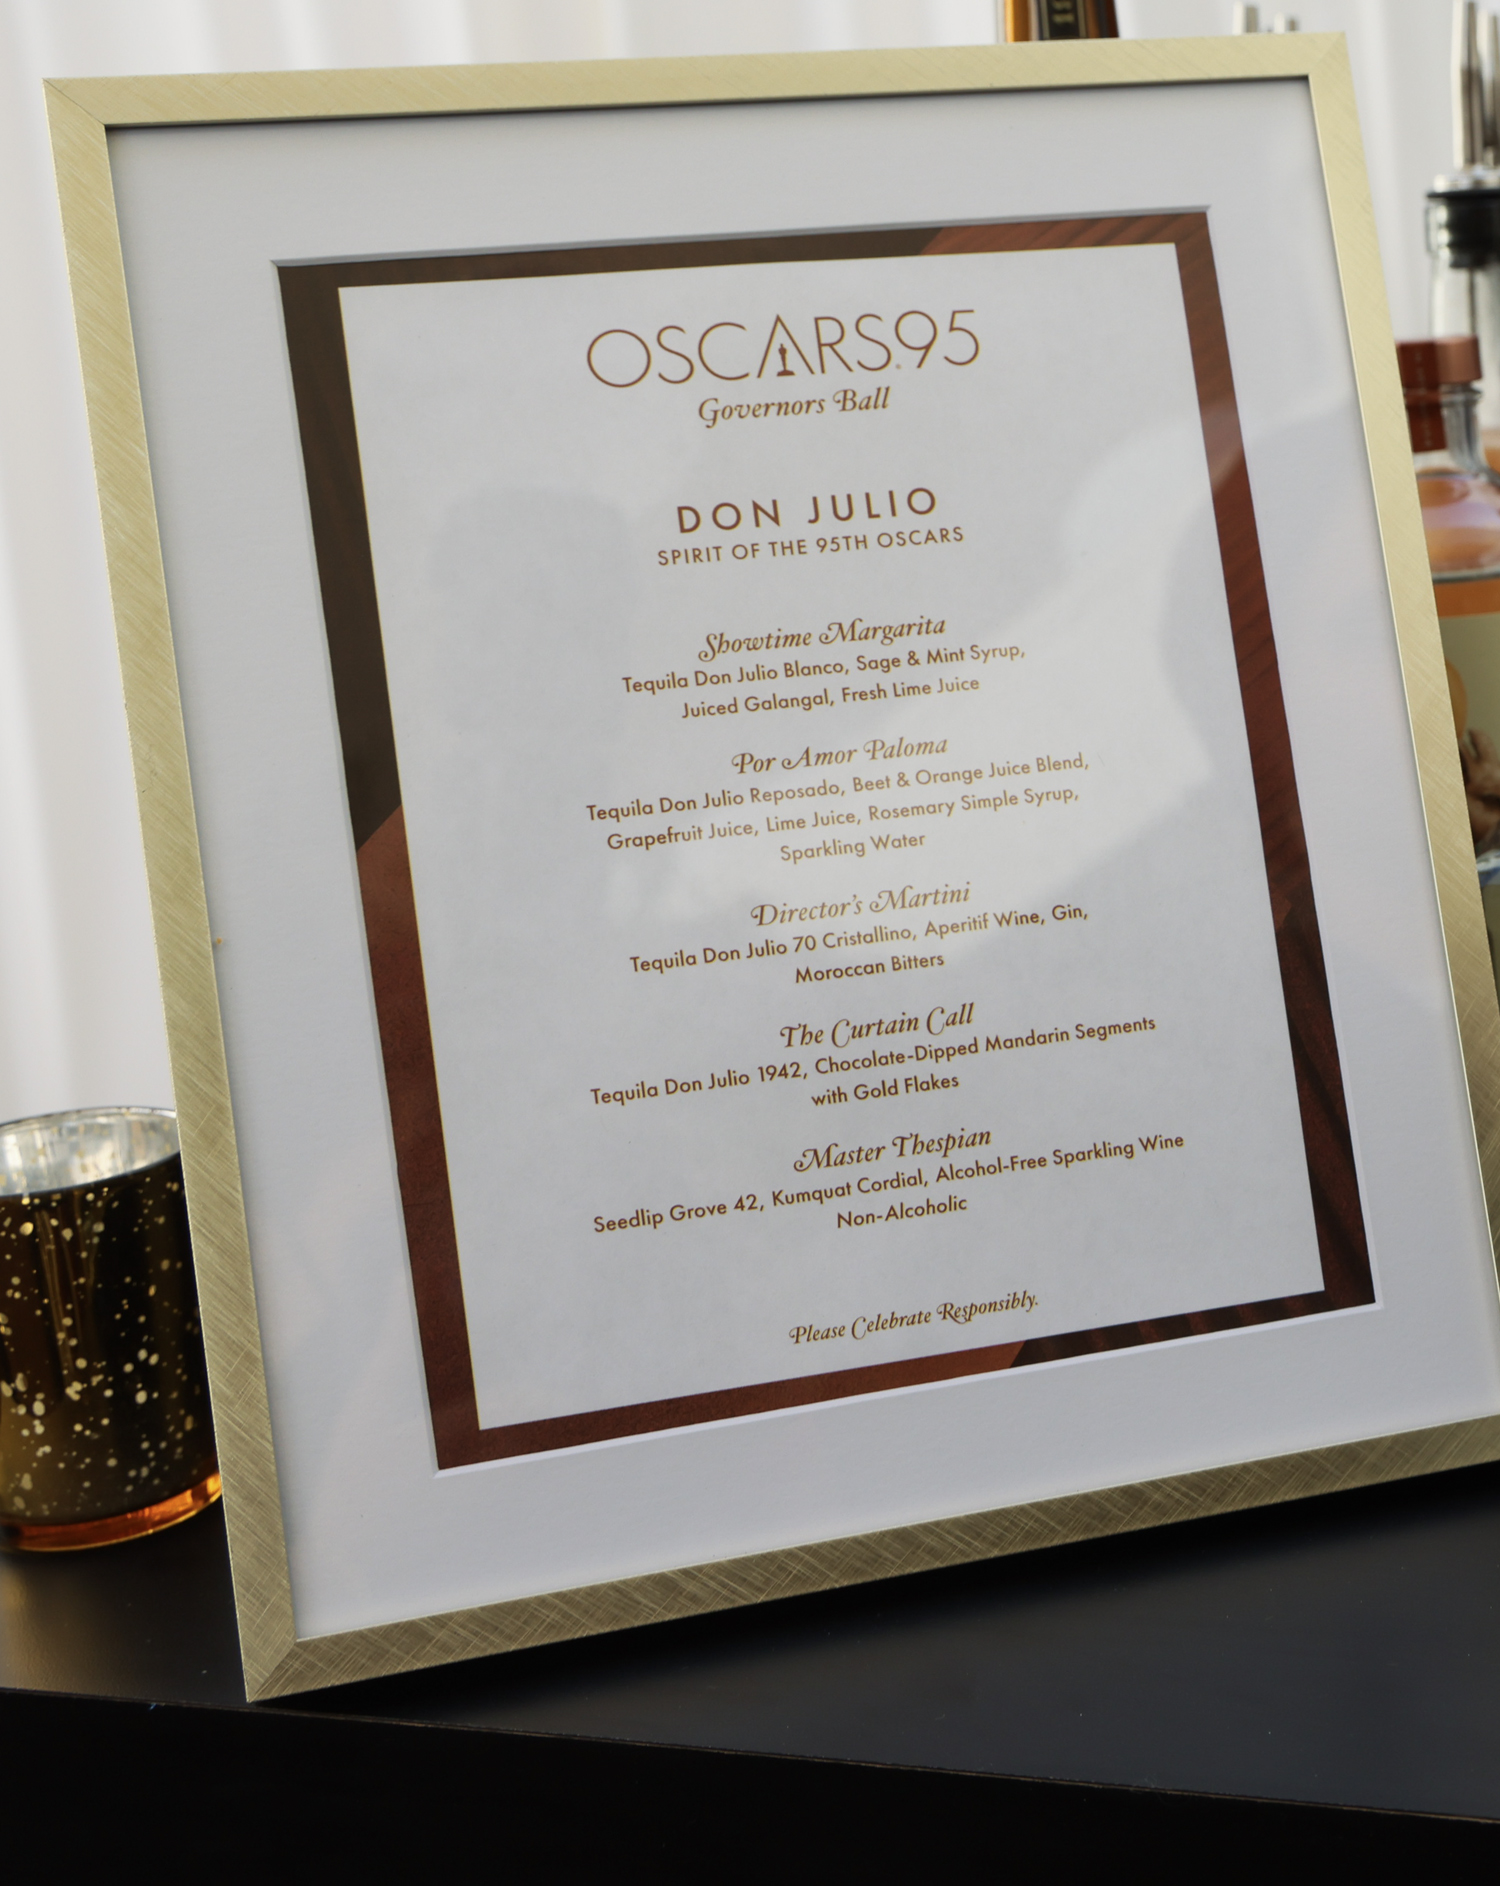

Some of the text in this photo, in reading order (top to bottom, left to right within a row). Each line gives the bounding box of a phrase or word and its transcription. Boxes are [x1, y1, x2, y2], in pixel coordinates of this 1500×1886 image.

[699, 387, 889, 428] Governors Ball
[678, 488, 935, 533] DON JULIO
[659, 527, 963, 565] SPIRIT OF THE 95TH OSCARS
[699, 616, 944, 662] Showtime Margarita
[623, 645, 1024, 695] Tequila Don Julio Blanco, Sage & Mint Syrup,
[683, 678, 978, 718] Juiced Galangal, Fresh Lime Juice
[732, 738, 946, 773] Por Amor Paloma
[587, 753, 1087, 822] Tequila Don Julio Reposado, Beet & Orange Juice Blend,
[608, 789, 1077, 850] Grapefruit Juice, Lime Juice, Rosemary Simple Syrup,
[782, 835, 924, 864] Sparkling Water
[870, 883, 969, 912] Martini
[630, 905, 1087, 974] Tequila Don Julio 70 Cristallino, Aperitif Wine, Gin,
[797, 956, 944, 983] Moroccan Bitters
[781, 1003, 973, 1047] The Curtain Call
[591, 1018, 1155, 1105] Tequila Don Julio 1942, Chocolate-Dipped Mandarin Segments
[812, 1074, 958, 1105] with Gold Flakes
[794, 1129, 990, 1172] Master Thespian
[595, 1135, 1183, 1232] Seedlip Grove 42, Kumquat Cordial, Alcohol-Free Sparkling Wine
[838, 1196, 966, 1228] Non-Alcoholic
[790, 1291, 1037, 1343] Please Celebrate Responsibly.
